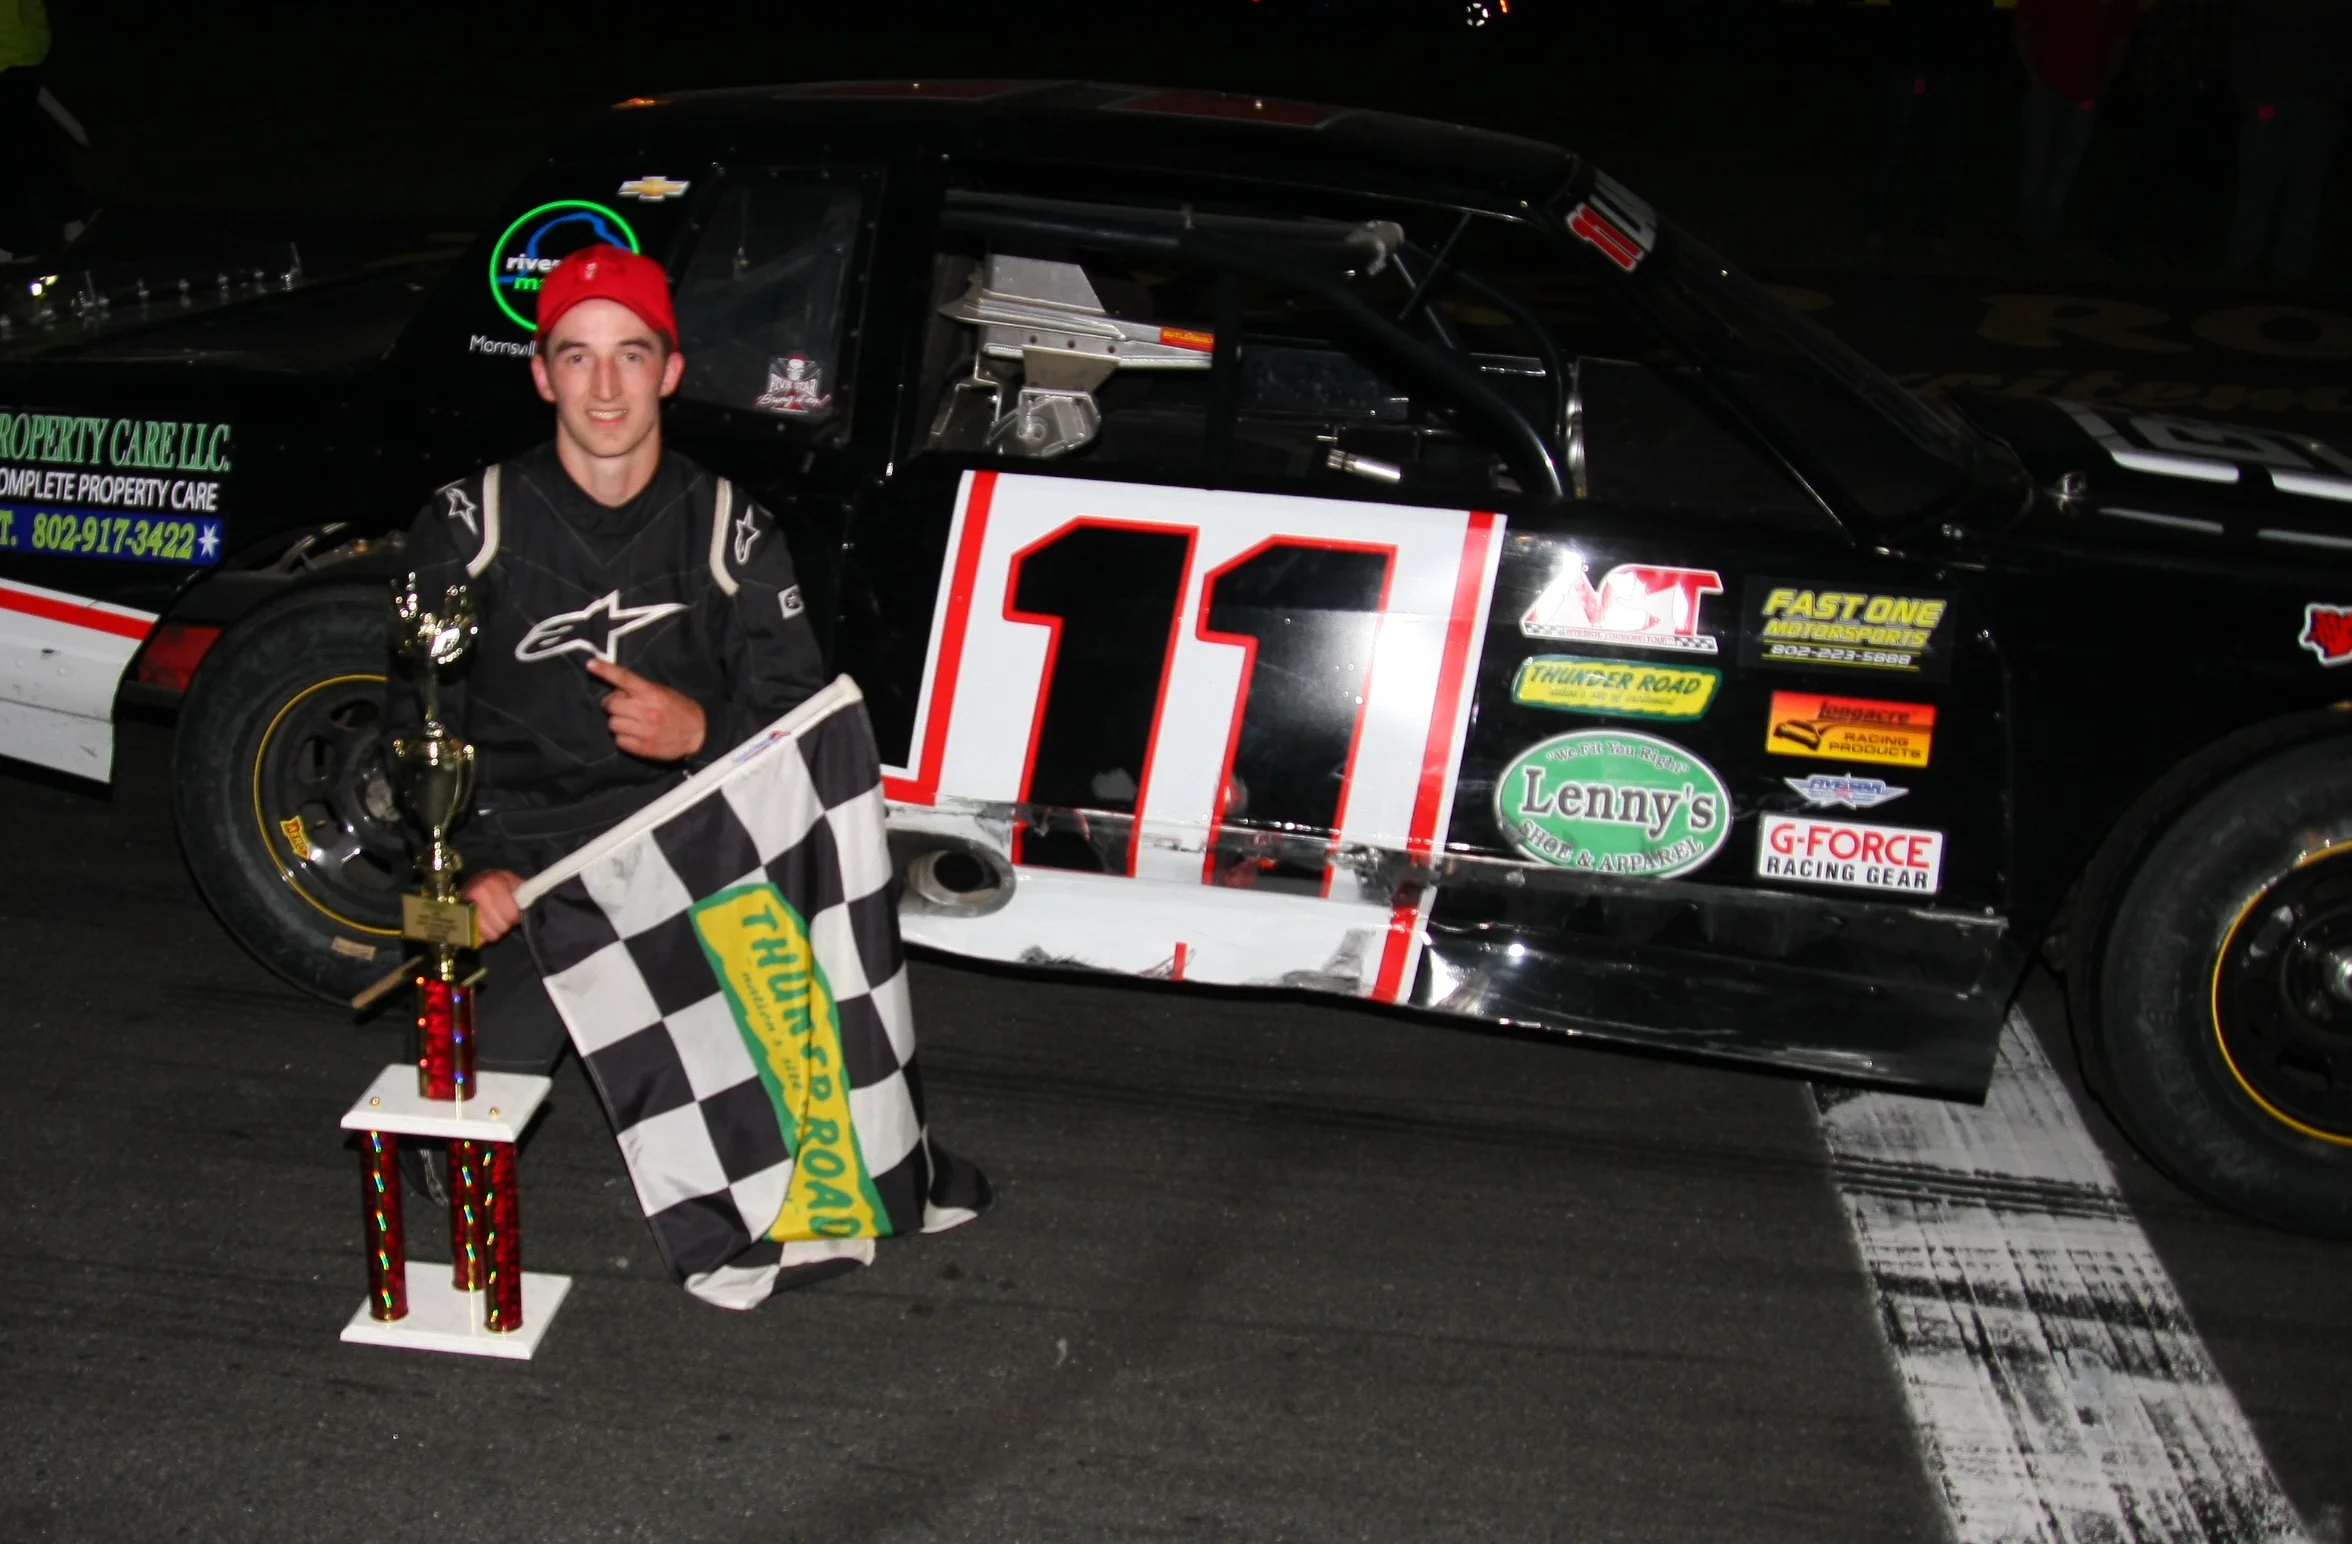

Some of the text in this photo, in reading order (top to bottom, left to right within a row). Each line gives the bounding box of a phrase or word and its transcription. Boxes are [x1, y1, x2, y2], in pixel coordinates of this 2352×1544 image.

[0, 413, 232, 473] ROPERTY CARE LLC.
[0, 467, 220, 512] OMPLETE PROPERTY CARE
[32, 512, 196, 560] 802-917-3422
[1762, 588, 1946, 628] FAST ONE
[1763, 617, 1931, 648] MOTORSPORTS
[1530, 666, 1702, 695] THUNDER ROAD
[1003, 514, 1398, 898] 11
[1580, 742, 1604, 755] Fit
[1607, 740, 1635, 757] You
[1829, 742, 1922, 758] PRODUCTS
[1844, 732, 1909, 746] RACING
[1521, 766, 1716, 839] Lenny's
[1520, 819, 1703, 872] SHOE & APPAREL
[1770, 823, 1933, 869] G-FORCE
[1767, 856, 1928, 889] RACING GEAR
[798, 1116, 862, 1238] ROAD
